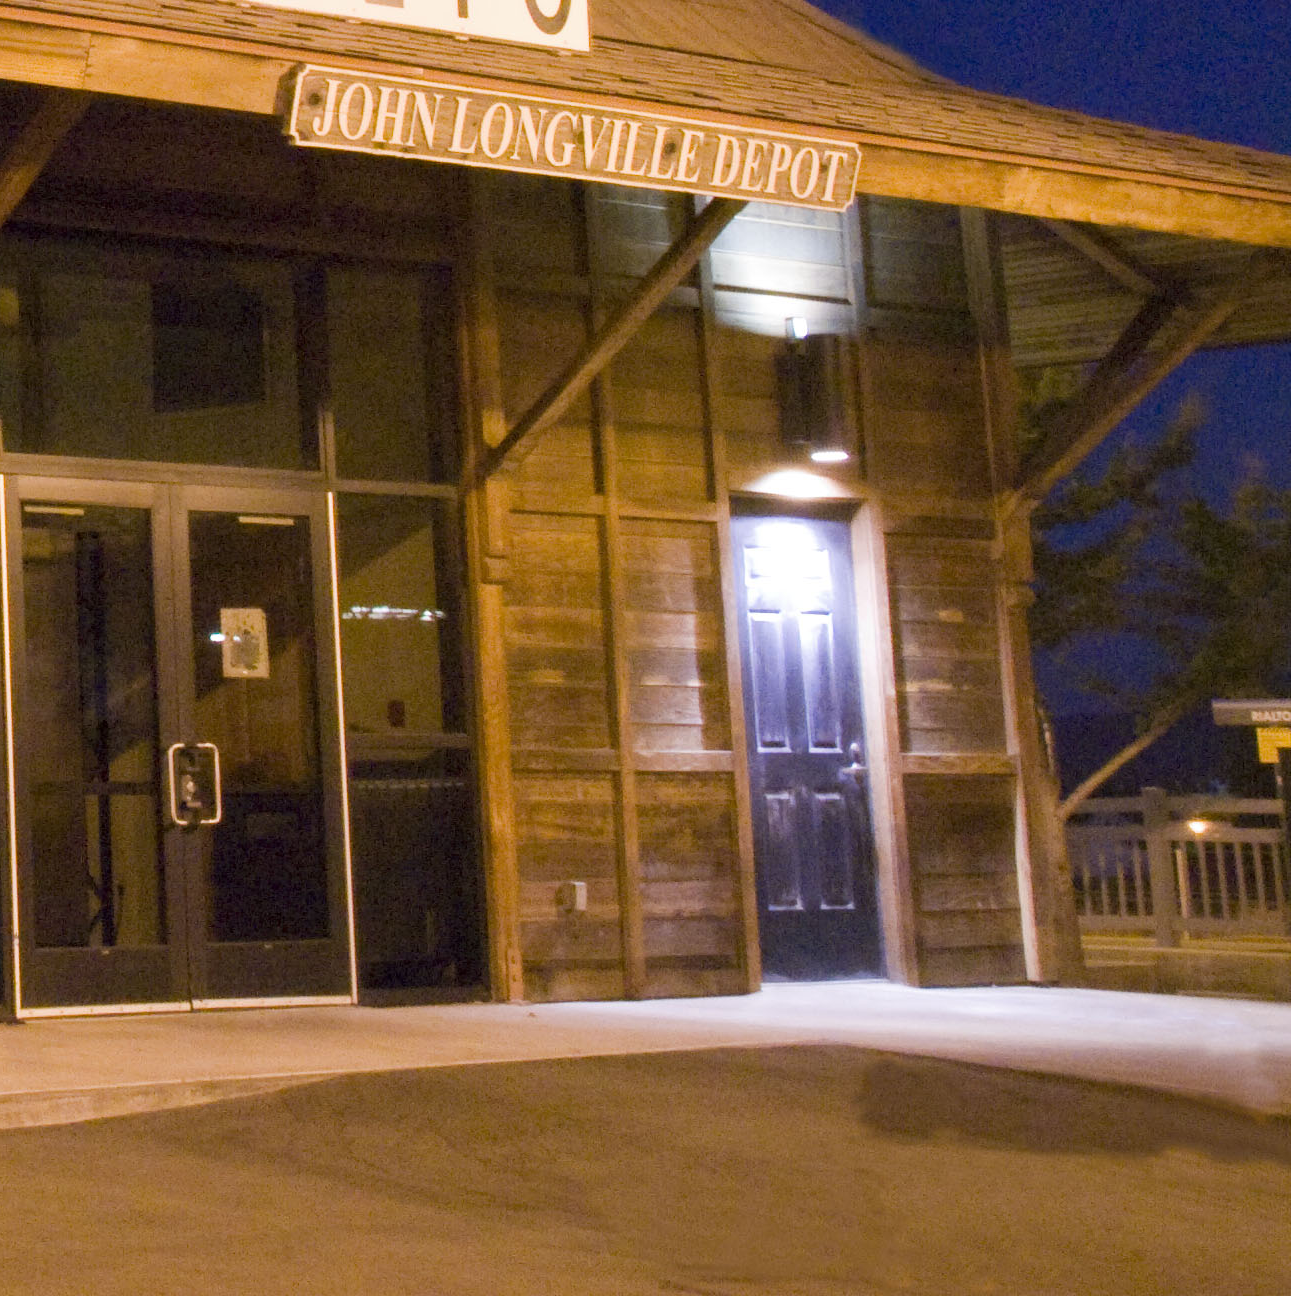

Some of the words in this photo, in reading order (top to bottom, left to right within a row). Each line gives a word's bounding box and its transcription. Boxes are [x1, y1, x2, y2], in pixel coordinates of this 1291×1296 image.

[312, 79, 444, 149] JOHN
[448, 96, 704, 182] LONGVILLE
[709, 134, 849, 202] DEPOT
